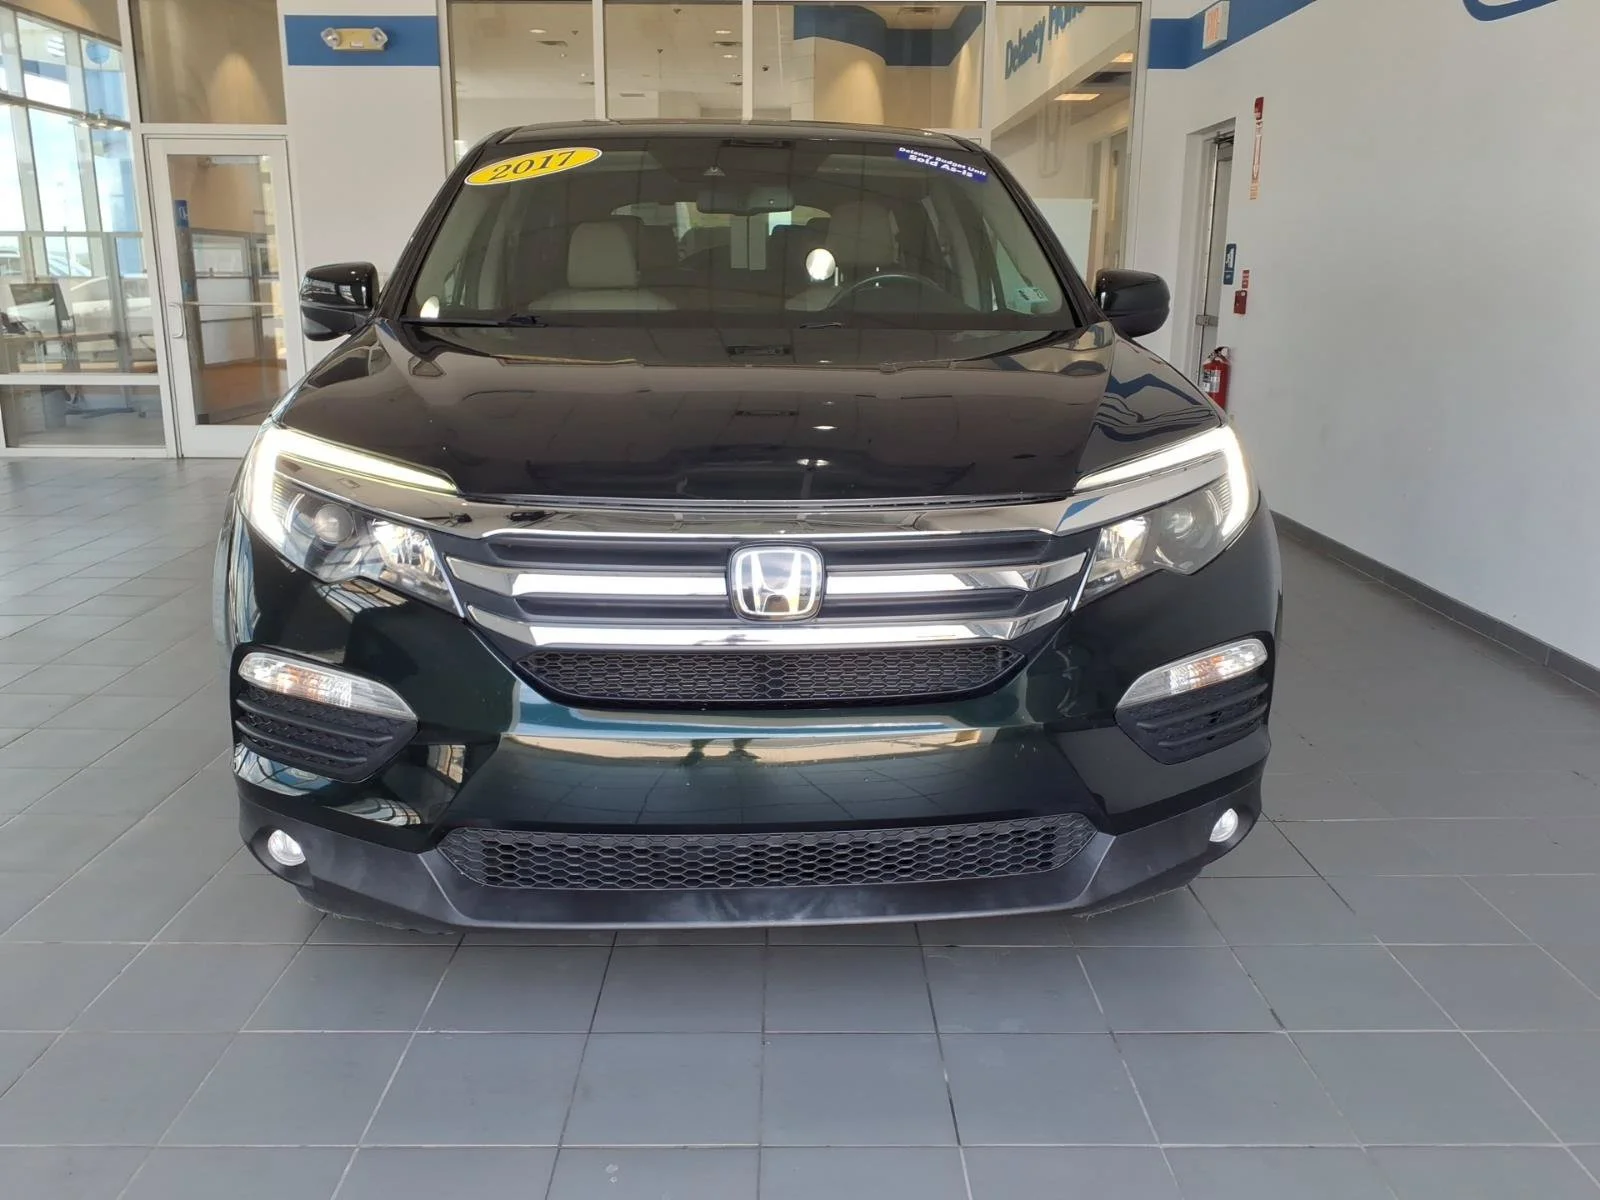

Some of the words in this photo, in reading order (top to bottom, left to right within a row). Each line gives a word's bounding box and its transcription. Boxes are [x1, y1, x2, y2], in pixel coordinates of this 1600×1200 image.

[487, 150, 577, 182] 2017
[899, 147, 935, 160] Delaney
[935, 157, 966, 169] Budget
[908, 154, 938, 167] Sold
